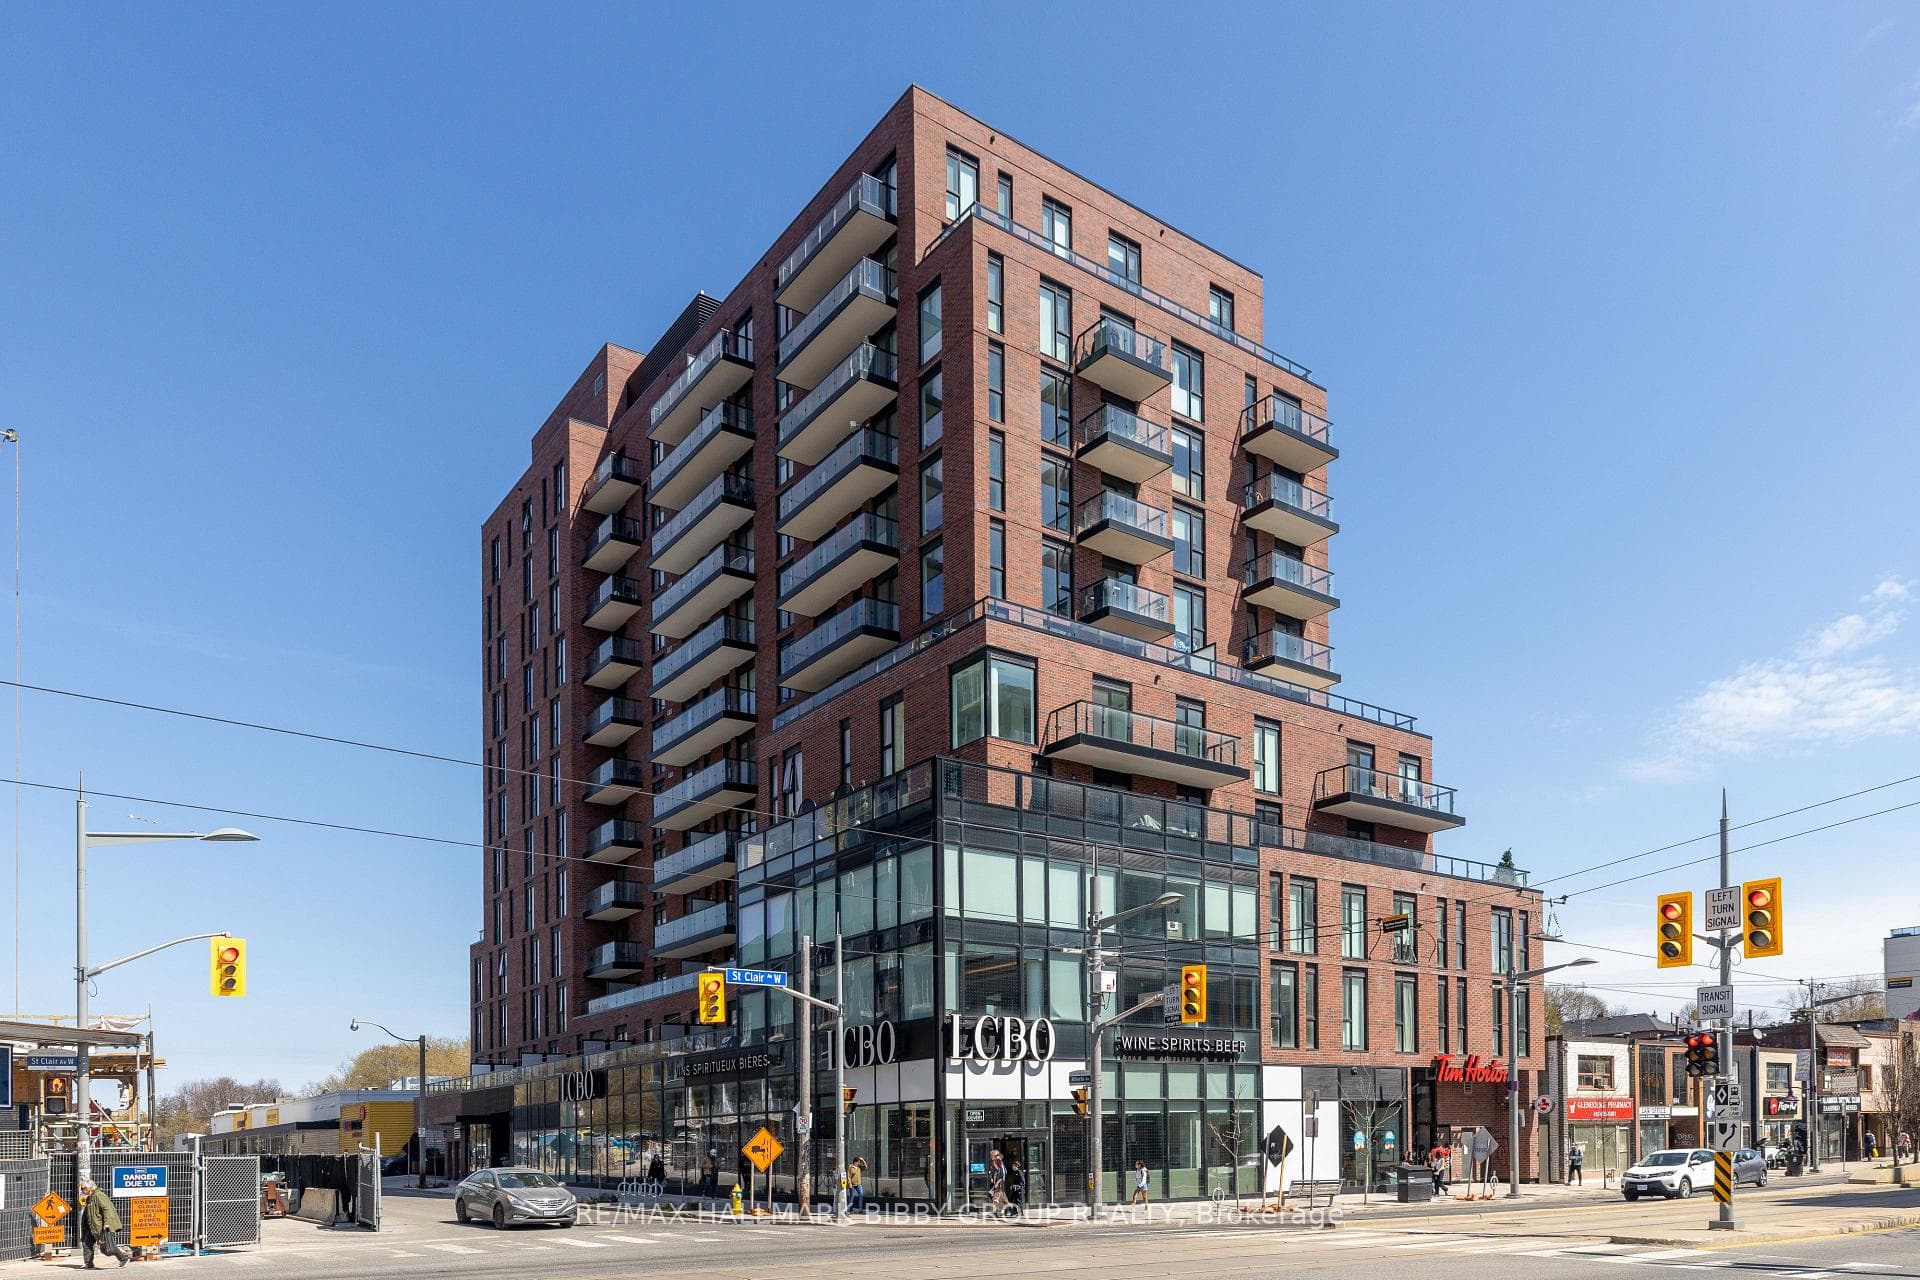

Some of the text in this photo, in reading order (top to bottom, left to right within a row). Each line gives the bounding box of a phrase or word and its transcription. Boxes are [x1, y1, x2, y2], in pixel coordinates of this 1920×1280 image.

[1712, 890, 1733, 902] LEFT
[1712, 903, 1735, 914] TURN
[1707, 916, 1738, 928] SIGNAL
[732, 971, 742, 981] St
[744, 972, 766, 983] Clair
[774, 974, 782, 984] W
[1700, 991, 1730, 1002] TRANSIT
[1702, 1004, 1729, 1015] SIGNAL
[950, 1013, 1056, 1062] LCBO
[827, 1020, 895, 1071] LCBO
[1121, 1036, 1247, 1053] WINE SPIRITS BEER
[31, 1057, 39, 1065] St
[40, 1057, 58, 1065] Clair
[67, 1057, 74, 1065] W
[675, 1064, 691, 1077] VINS
[693, 1058, 736, 1075] SPIRITUEUX
[1434, 1054, 1463, 1084] Tim
[561, 1070, 595, 1103] LCBO
